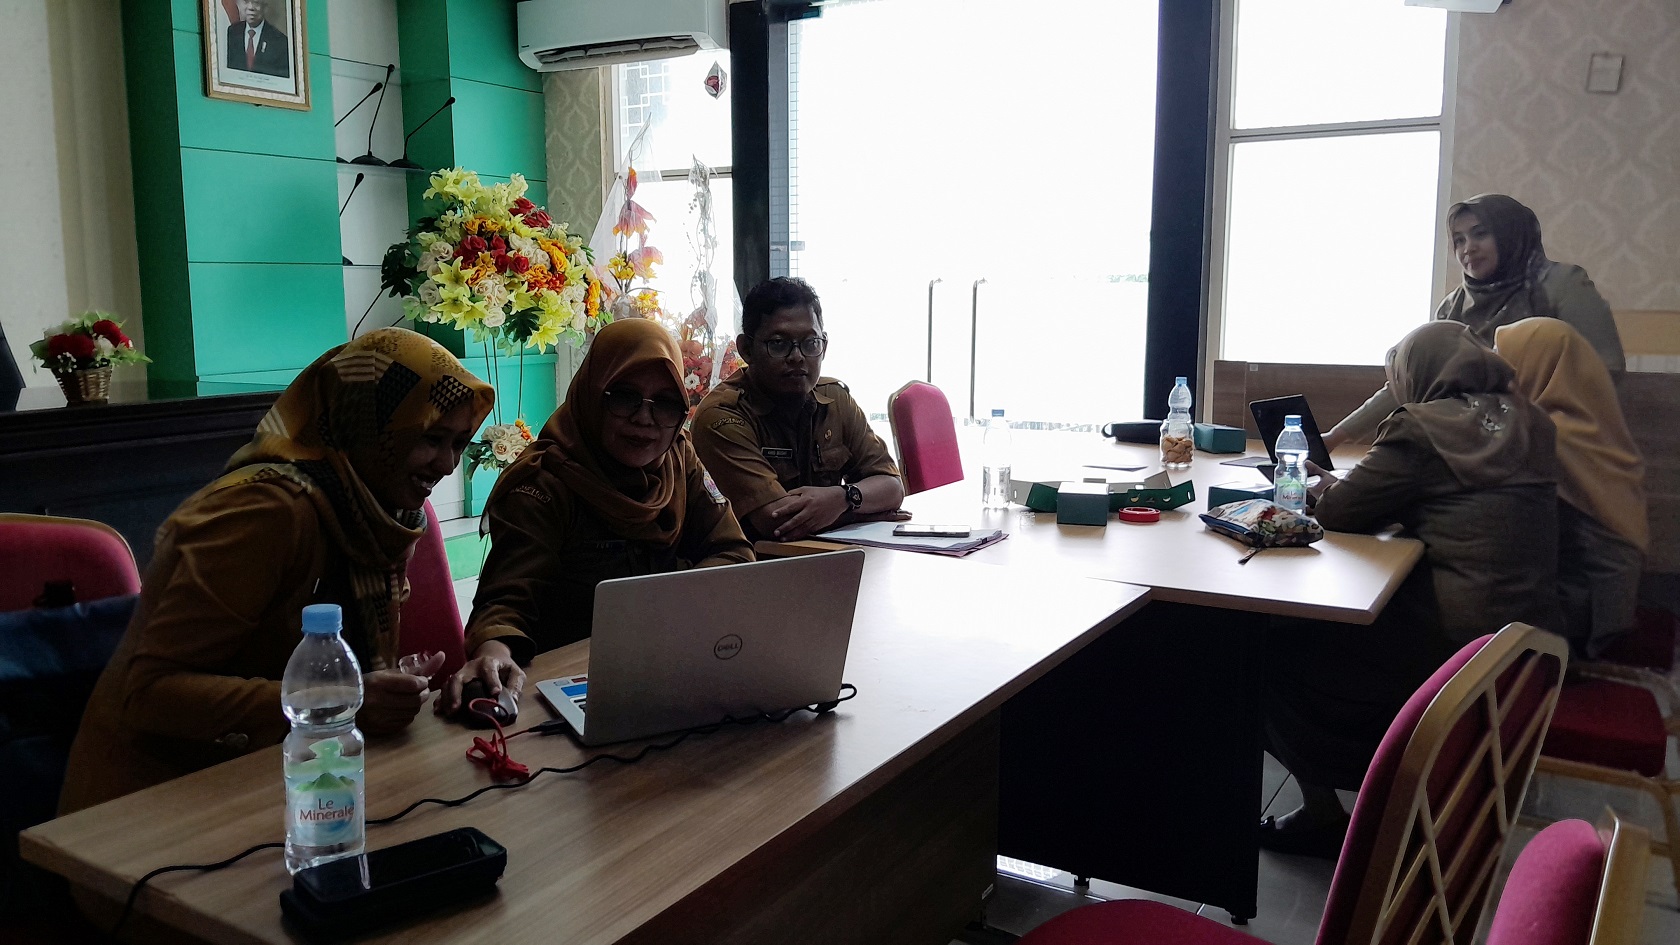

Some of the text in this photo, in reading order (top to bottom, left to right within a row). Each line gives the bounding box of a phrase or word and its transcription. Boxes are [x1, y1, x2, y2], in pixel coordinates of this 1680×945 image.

[717, 643, 739, 652] DELL
[318, 798, 334, 811] Le
[299, 805, 355, 822] Minerale
